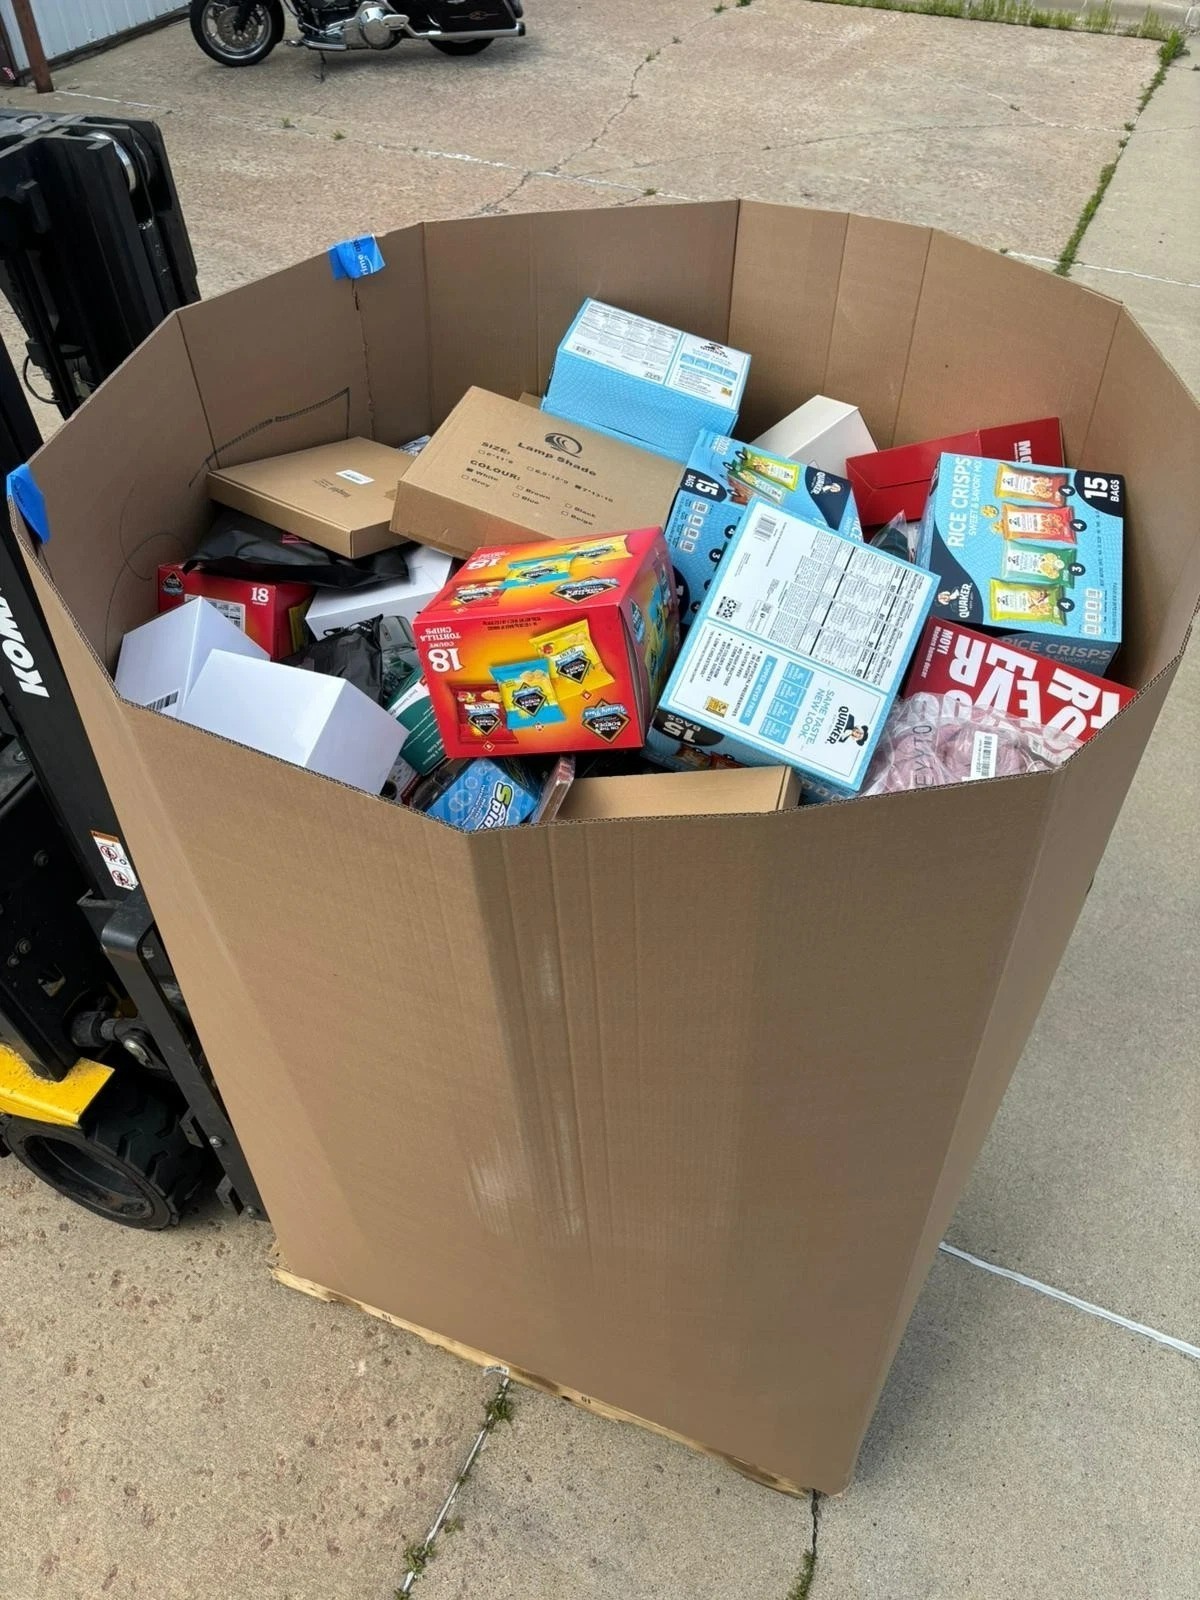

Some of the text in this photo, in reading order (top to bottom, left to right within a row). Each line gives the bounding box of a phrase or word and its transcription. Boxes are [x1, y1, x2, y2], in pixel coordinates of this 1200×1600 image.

[517, 440, 598, 478] Lamp Shade
[469, 459, 521, 482] COLOUR:
[684, 474, 695, 488] BAGS
[695, 478, 720, 496] 15
[1063, 486, 1073, 495] 4
[1084, 476, 1108, 499] 15
[1110, 479, 1120, 503] BAGS
[947, 457, 972, 548] RICE CRISPS
[1075, 522, 1084, 530] 4
[1072, 565, 1083, 573] 3
[250, 586, 270, 603] 18
[1062, 601, 1071, 610] 4
[420, 632, 461, 641] TORTILLA
[425, 626, 452, 634] CHIPS
[936, 629, 954, 655] MOYI
[1046, 642, 1112, 661] CRISPS
[427, 647, 464, 672] 18
[810, 687, 827, 712] NEW
[667, 714, 702, 733] BAGS
[805, 689, 836, 746] SAME TASTE.
[825, 705, 852, 746] QUAKER
[662, 720, 697, 744] 15
